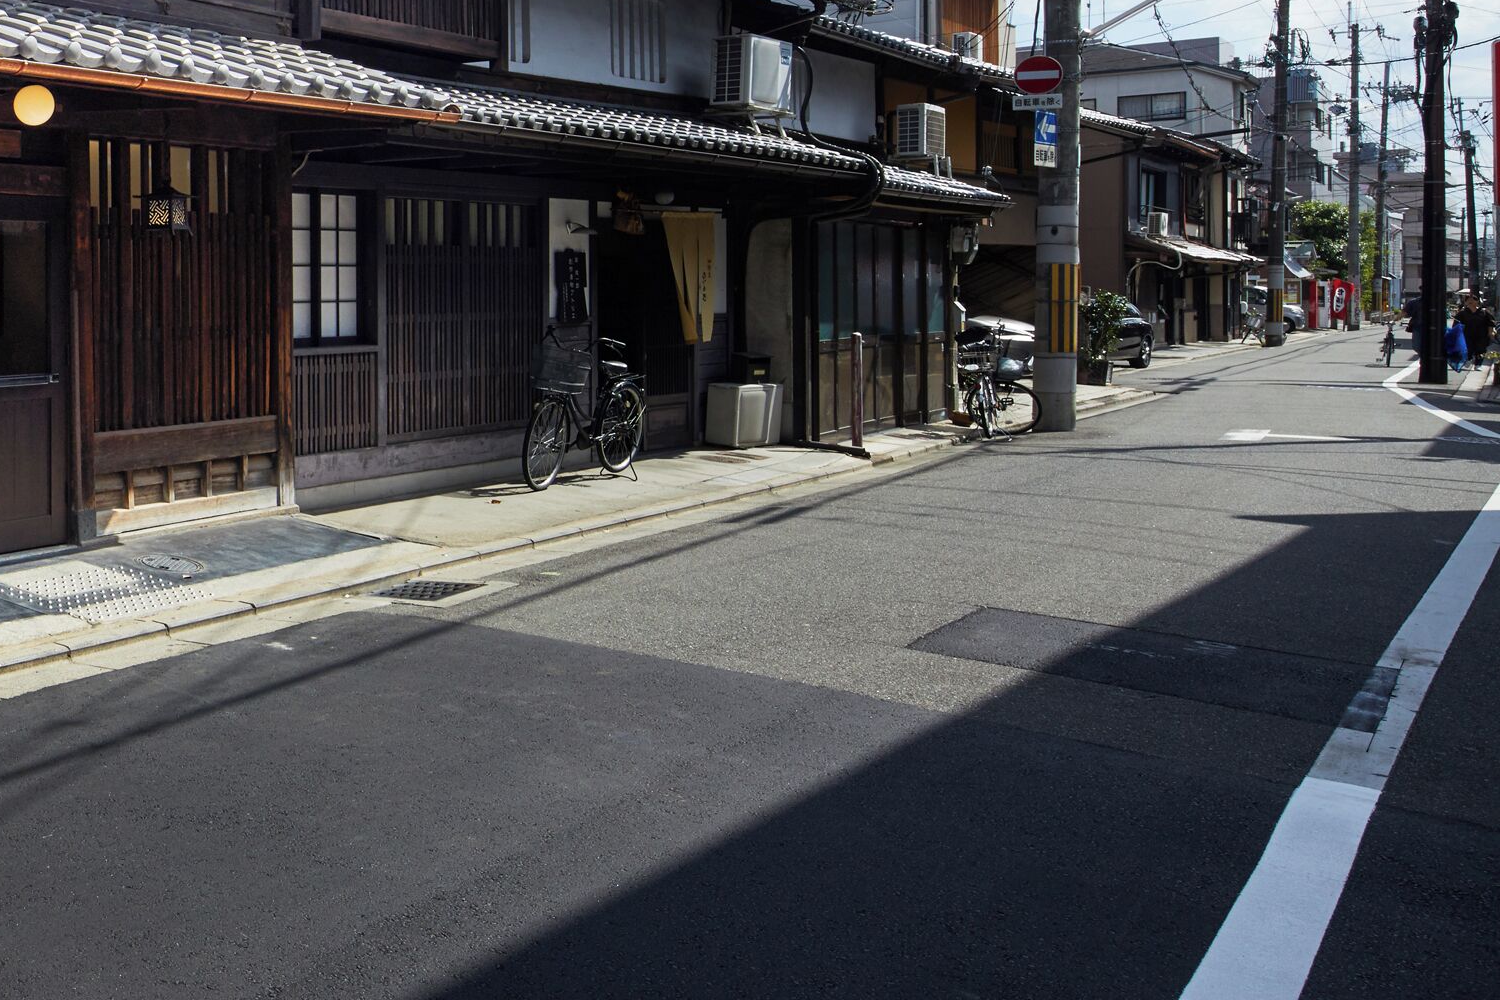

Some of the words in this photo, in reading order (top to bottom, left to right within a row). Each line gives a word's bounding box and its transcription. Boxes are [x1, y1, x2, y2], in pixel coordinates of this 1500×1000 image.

[1015, 97, 1060, 107] 自転車を除く
[1036, 150, 1055, 163] 自転車を除
